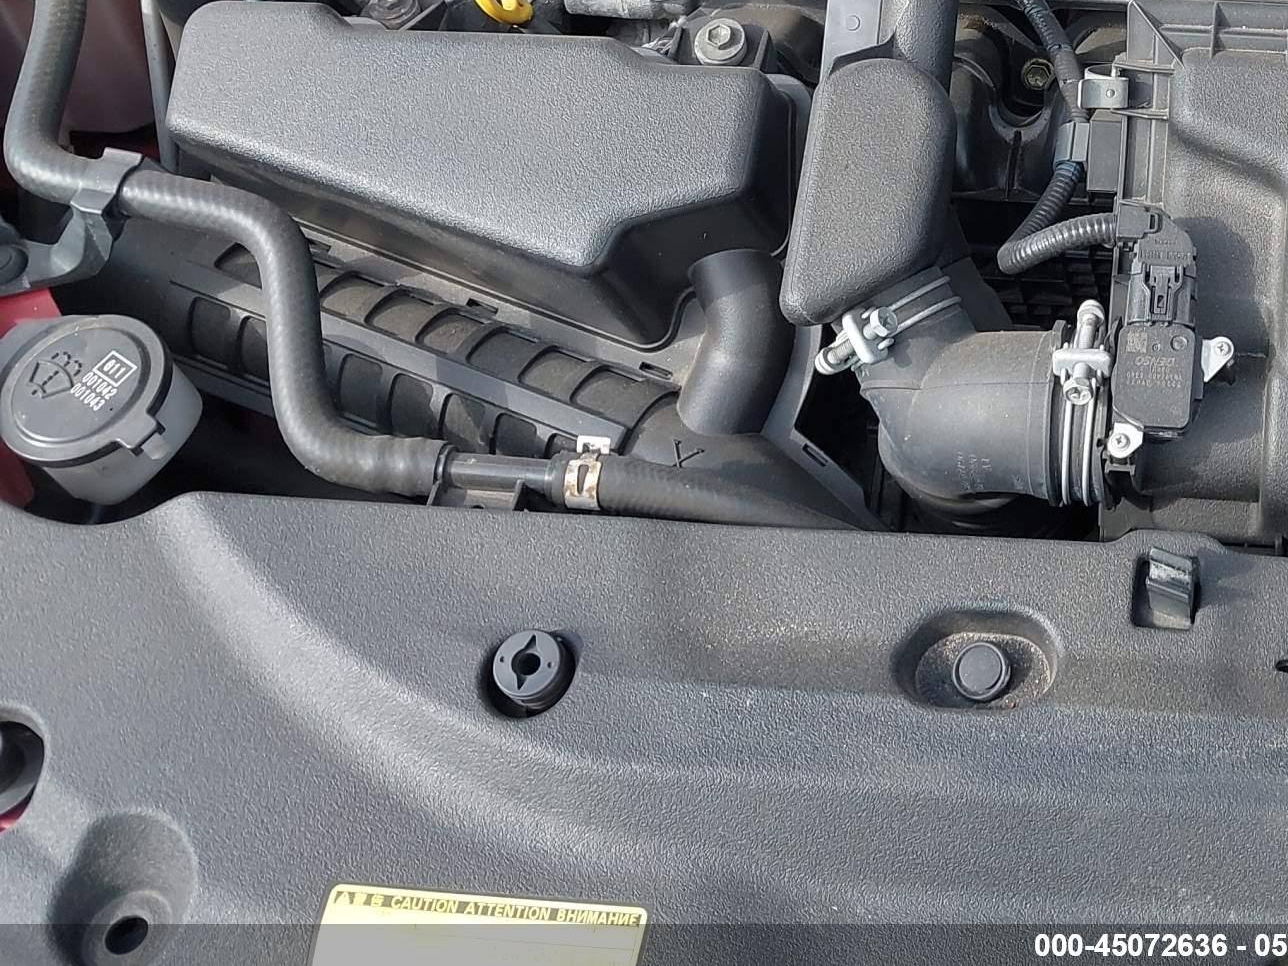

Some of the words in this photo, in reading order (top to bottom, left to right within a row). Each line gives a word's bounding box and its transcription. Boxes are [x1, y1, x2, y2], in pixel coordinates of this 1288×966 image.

[70, 383, 105, 411] 001043
[390, 895, 457, 915] CAUTION
[463, 903, 550, 921] ATTENTION
